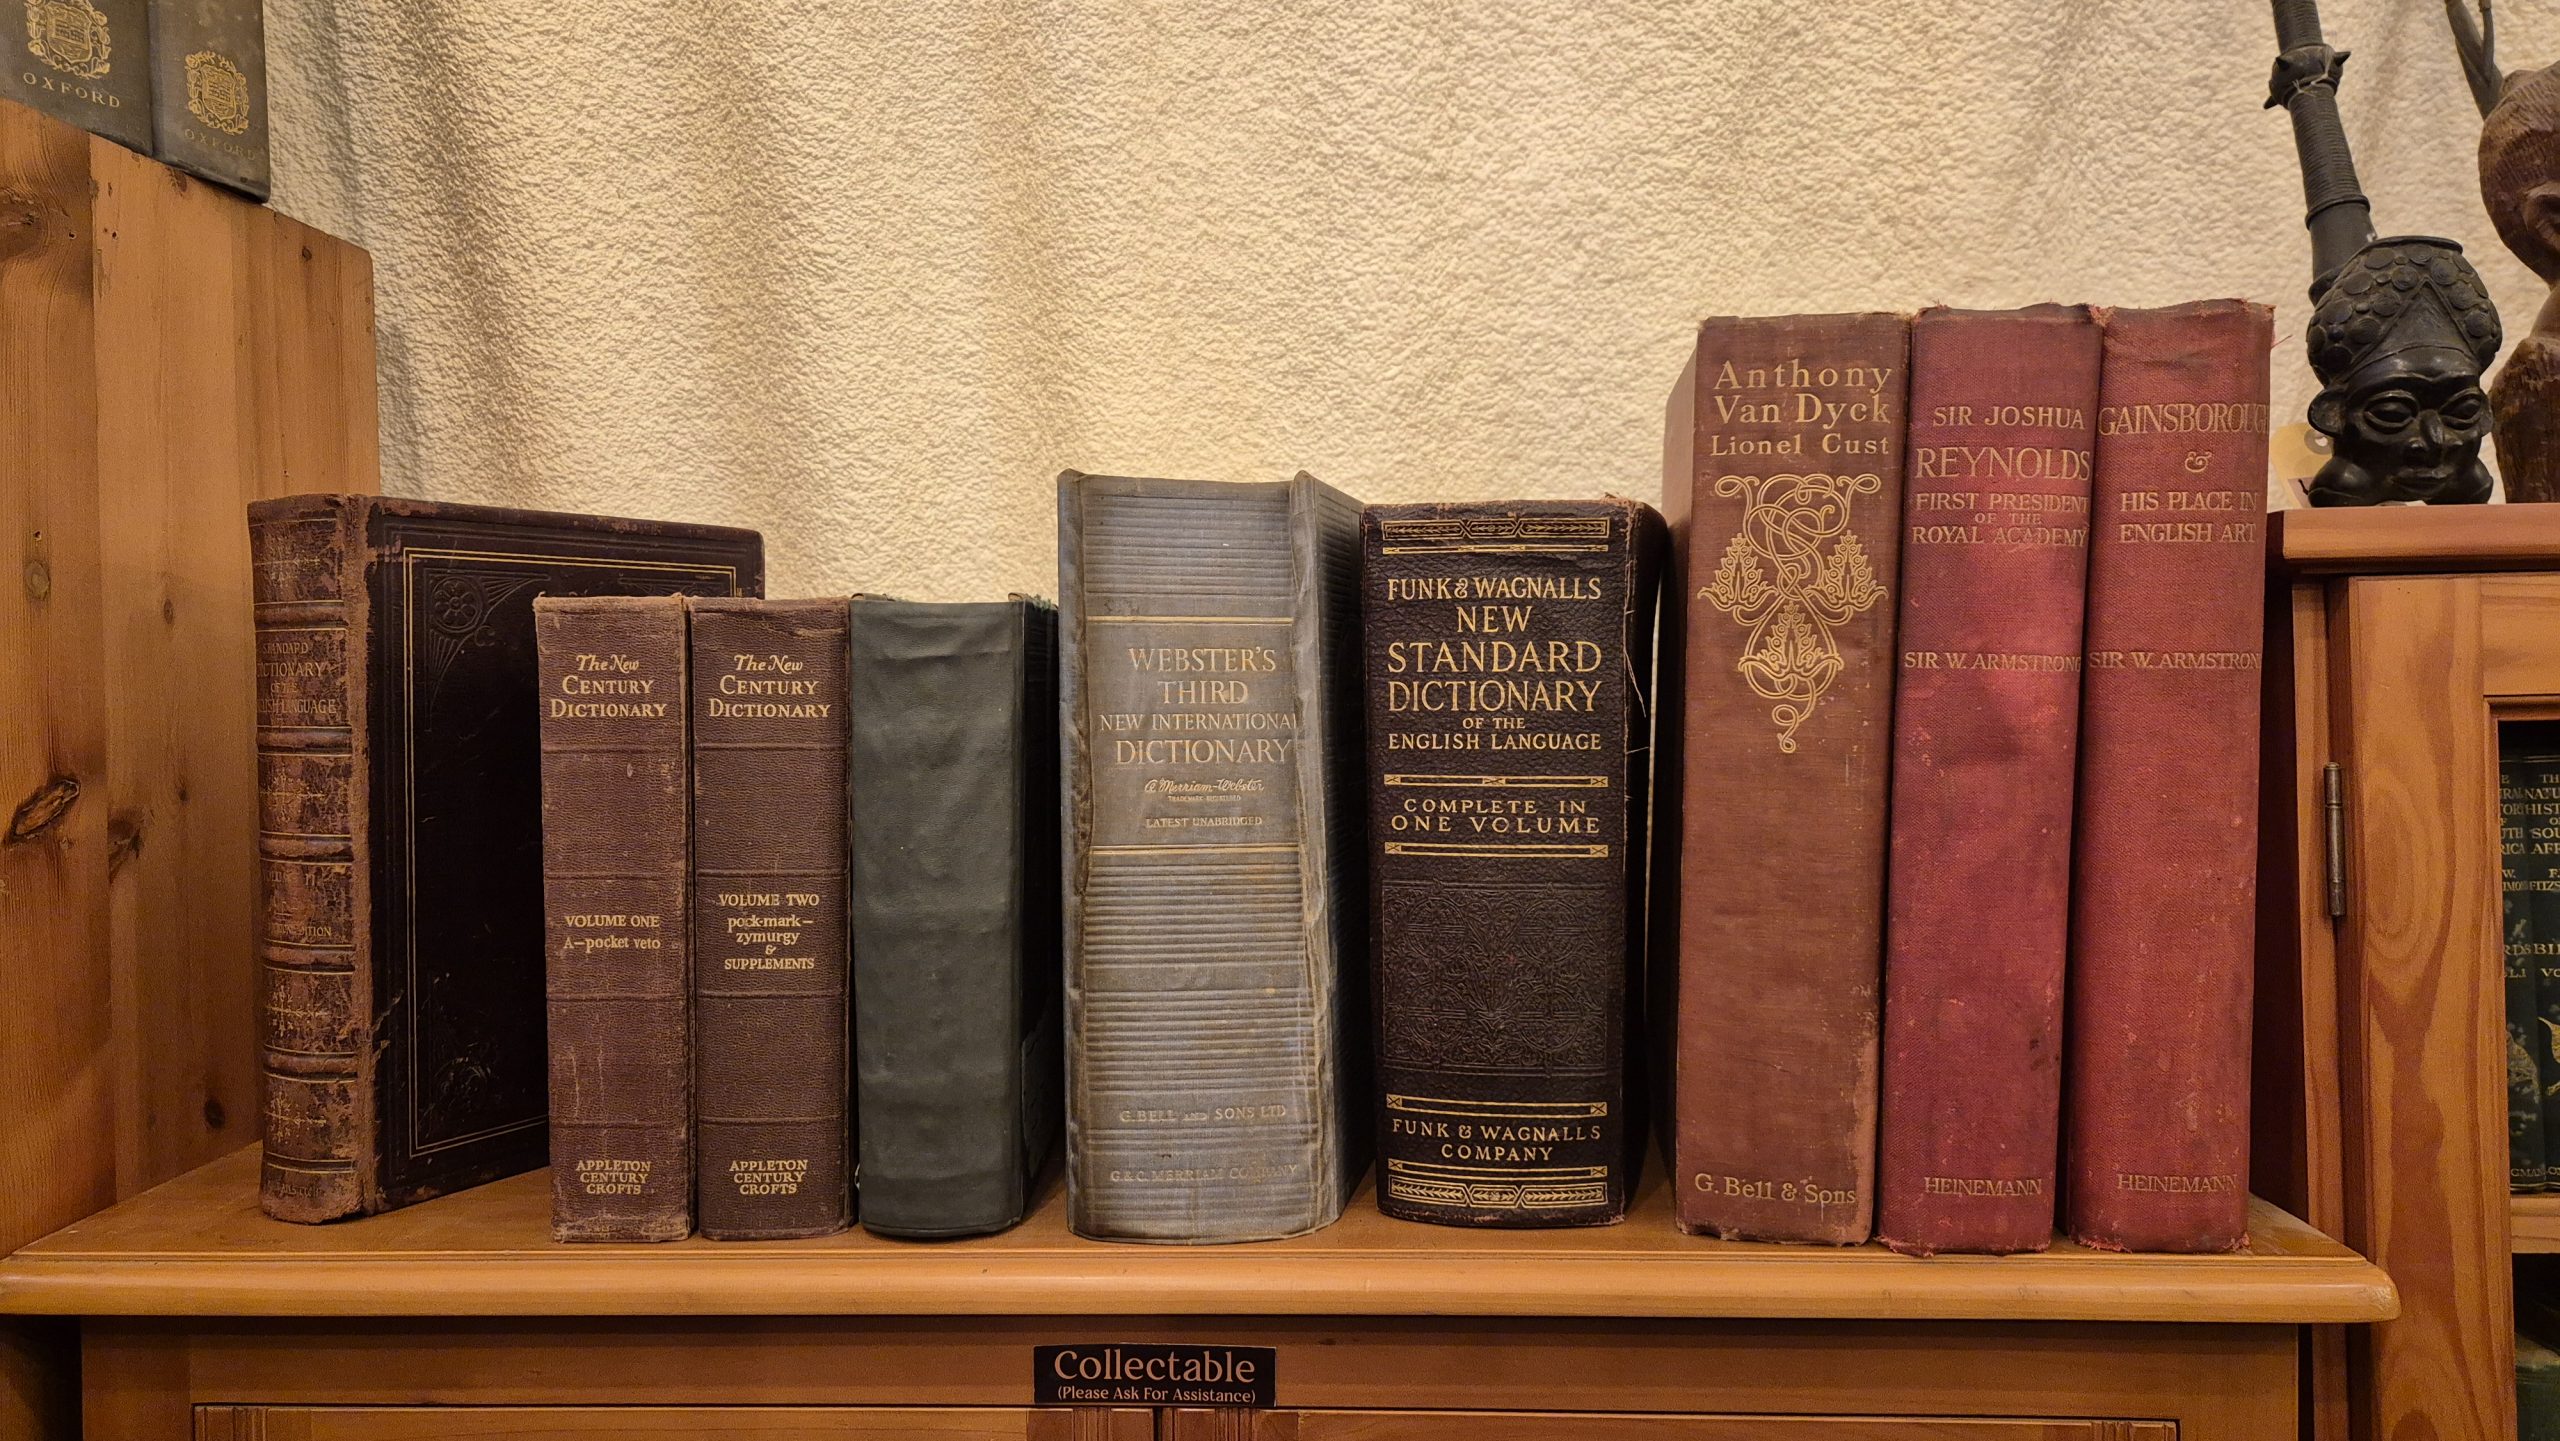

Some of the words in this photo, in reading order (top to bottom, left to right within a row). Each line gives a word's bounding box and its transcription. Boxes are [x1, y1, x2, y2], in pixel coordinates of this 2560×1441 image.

[23, 72, 120, 108] OXFORD
[1713, 358, 1892, 393] Anthony
[1714, 394, 1781, 424] Van
[1795, 393, 1891, 430] Dyck
[1933, 406, 1974, 428] SIR
[1985, 406, 2085, 430] JOSHUA
[1710, 433, 1802, 456] Lionel
[1822, 433, 1889, 455] Cust
[1915, 447, 2090, 481] REYNOLDS
[2185, 451, 2213, 473] &
[1916, 493, 1979, 511] FIRST
[1988, 493, 2089, 513] PRESIDENT
[2120, 492, 2159, 512] HIS
[2168, 491, 2233, 511] PLACE
[2240, 491, 2258, 512] IN
[1974, 513, 1997, 524] OF
[2009, 513, 2043, 525] THE
[1912, 526, 1985, 544] ROYAL
[1993, 526, 2088, 548] ACADEMY
[2119, 523, 2213, 543] ENGLISH
[2221, 523, 2257, 543] ART
[1387, 578, 1451, 600] FUNK
[1454, 577, 1468, 599] &
[1474, 577, 1602, 599] WAGNALLS
[1456, 606, 1533, 633] NEW
[576, 654, 608, 671] The
[609, 654, 640, 673] New
[734, 654, 766, 671] The
[767, 654, 803, 674] New
[1129, 646, 1276, 672] WEBSTER'S
[1387, 640, 1602, 673] STANDARD
[1904, 652, 1940, 669] SIR
[1945, 652, 1966, 670] W.
[2089, 651, 2123, 669] SIR
[2130, 652, 2153, 669] W.
[1158, 681, 1248, 704] THIRD
[1388, 680, 1602, 712] DICTIONARY
[1100, 714, 1143, 730] NEW
[1462, 718, 1484, 730] OF
[1492, 718, 1526, 729] THE
[1388, 733, 1480, 750] ENGLISH
[1491, 733, 1602, 750] LANGUAGE
[1116, 738, 1290, 765] DICTIONARY
[1159, 778, 1264, 794] Merriam-Webster
[1404, 798, 1537, 814] COMPLETE
[1559, 801, 1585, 814] IN
[1146, 817, 1189, 828] LATEST
[1193, 816, 1263, 828] UNABRIDGED
[1391, 815, 1451, 832] ONE
[1470, 817, 1600, 834] VOLUME
[719, 894, 780, 906] VOLUME
[786, 894, 820, 906] TWO
[565, 915, 627, 928] VOLUME
[631, 915, 661, 928] ONE
[634, 938, 661, 950] veto
[736, 932, 800, 945] zymurgy
[765, 945, 776, 955] &
[724, 958, 815, 970] SUPPLEMENTS
[1215, 1106, 1255, 1120] SONS
[1261, 1104, 1286, 1118] LTD
[1392, 1118, 1450, 1138] FUNK
[1458, 1125, 1472, 1139] &
[1480, 1126, 1601, 1142] WAGNALLS
[1441, 1144, 1553, 1161] COMPANY
[576, 1159, 651, 1172] APPLETON
[729, 1159, 808, 1172] APPLETON
[580, 1172, 648, 1183] CENTURY
[733, 1171, 806, 1184] CENTURY
[1924, 1176, 2042, 1197] HEINEMANN
[2116, 1173, 2238, 1194] HEINEMANN
[586, 1183, 641, 1195] CROFTS
[739, 1184, 797, 1195] CROFTS
[1694, 1173, 1720, 1194] G.
[1724, 1176, 1775, 1200] Bell
[1781, 1183, 1798, 1201] &
[1804, 1184, 1857, 1205] Sons
[1054, 1348, 1256, 1383] Collectable
[1057, 1386, 1110, 1401] (Please
[1113, 1386, 1139, 1401] Ask
[1144, 1386, 1169, 1401] For
[1173, 1387, 1256, 1405] Assistance)
